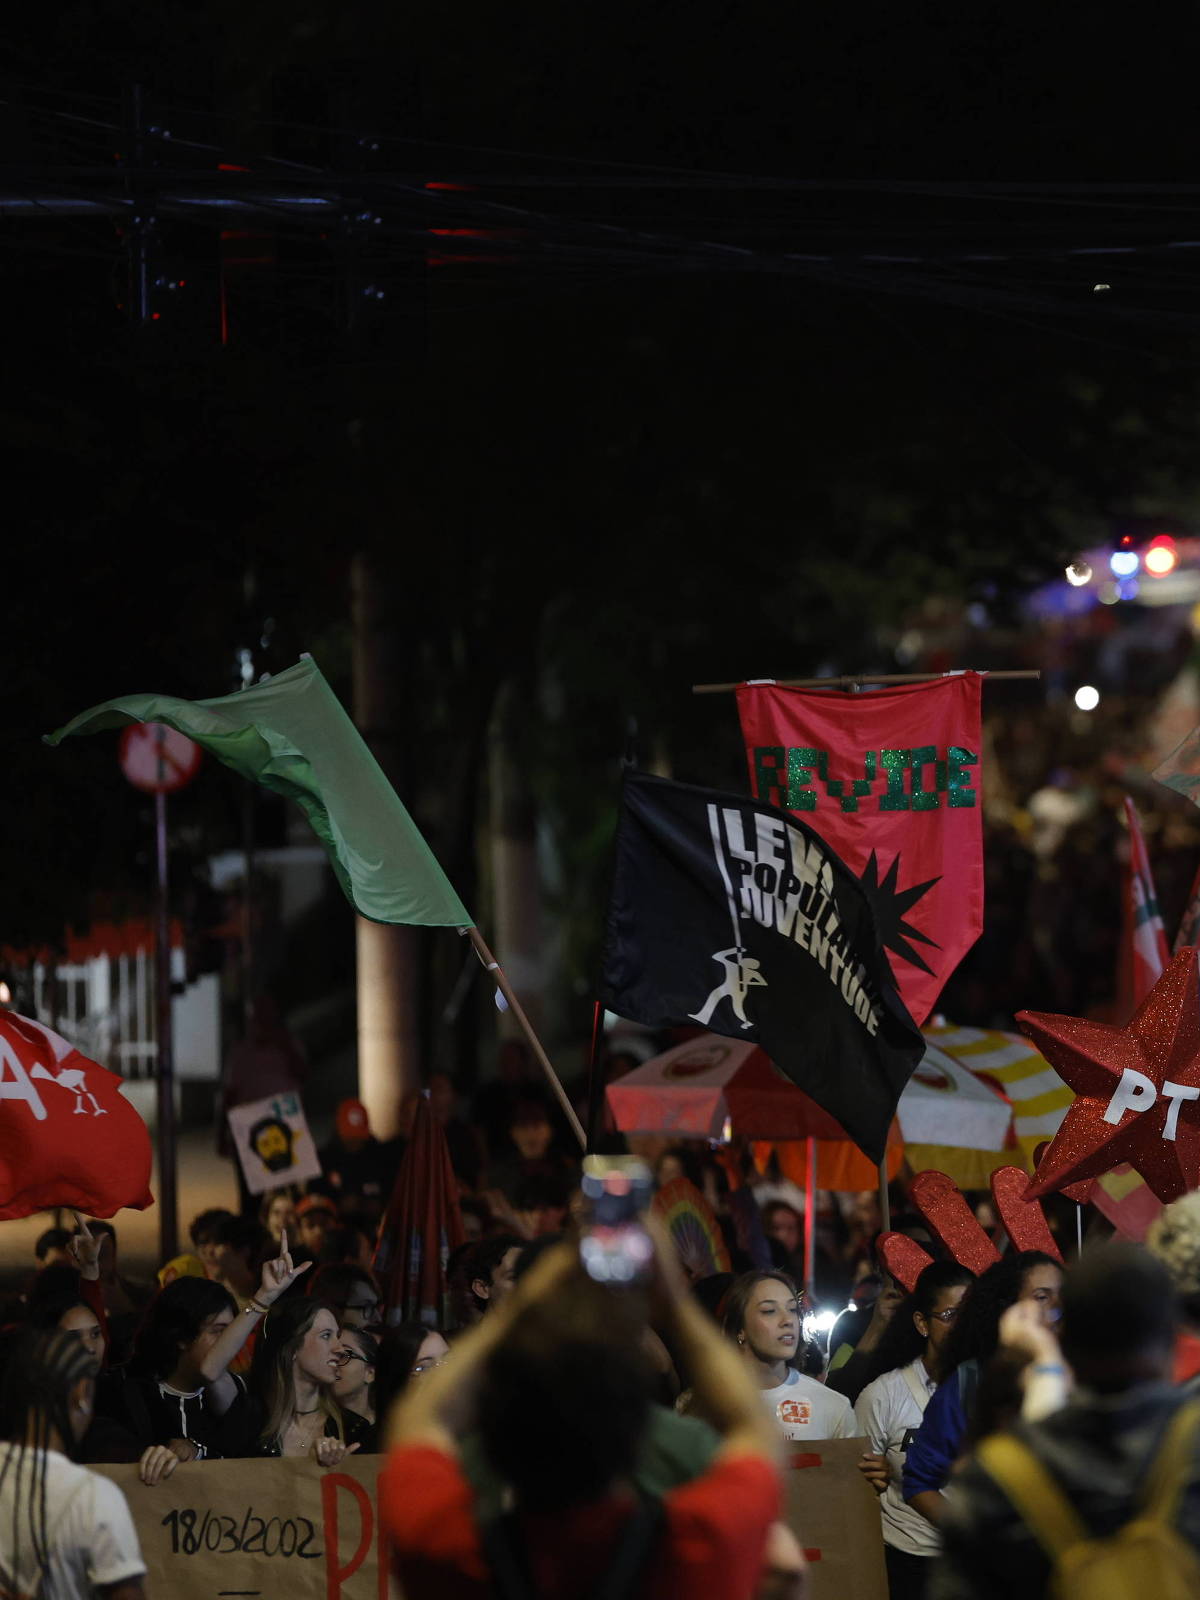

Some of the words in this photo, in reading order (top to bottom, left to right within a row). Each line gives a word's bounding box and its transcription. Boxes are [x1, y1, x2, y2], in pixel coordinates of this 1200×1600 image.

[754, 745, 978, 813] REVIDE
[1102, 1067, 1200, 1142] PT
[162, 1506, 322, 1558] 18/03/2002
